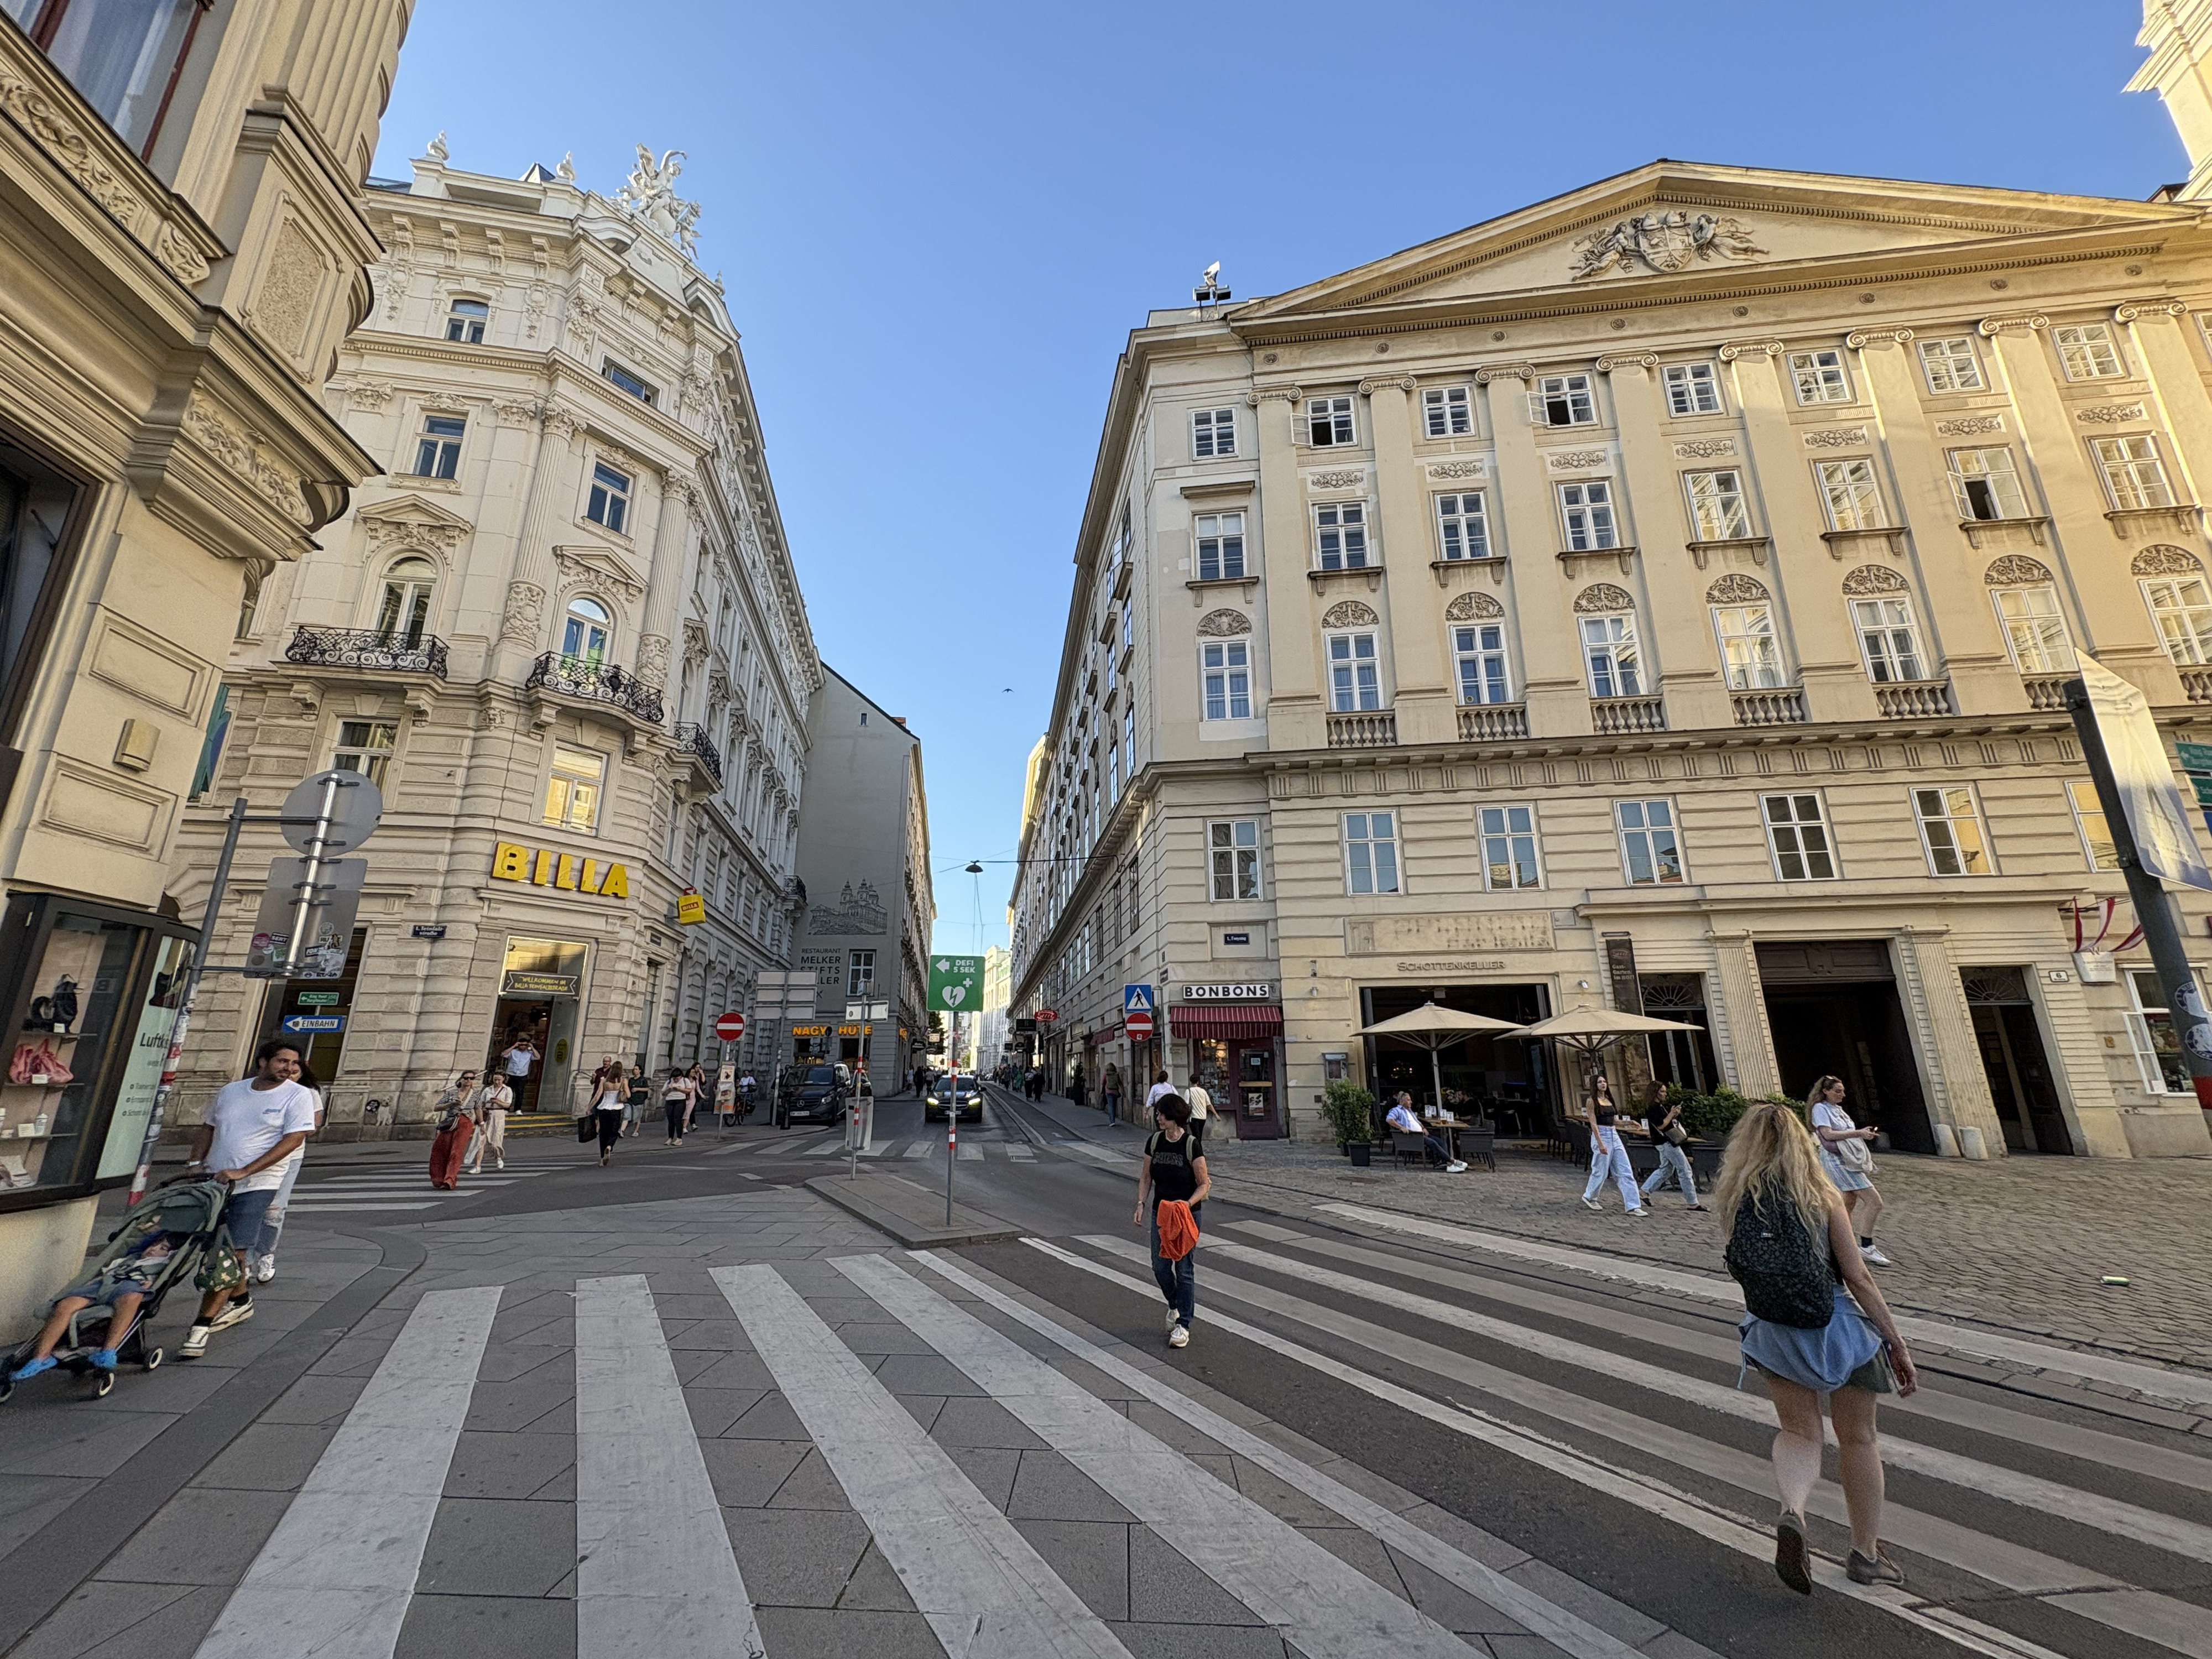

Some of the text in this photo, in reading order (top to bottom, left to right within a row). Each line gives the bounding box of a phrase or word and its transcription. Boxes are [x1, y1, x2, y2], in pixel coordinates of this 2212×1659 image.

[492, 842, 629, 898] BILLA
[1397, 961, 1506, 971] SCHOTTENKELLER
[520, 976, 559, 984] WILLKOMMEN
[1185, 985, 1267, 997] BONBONS
[792, 1026, 828, 1036] NAGY
